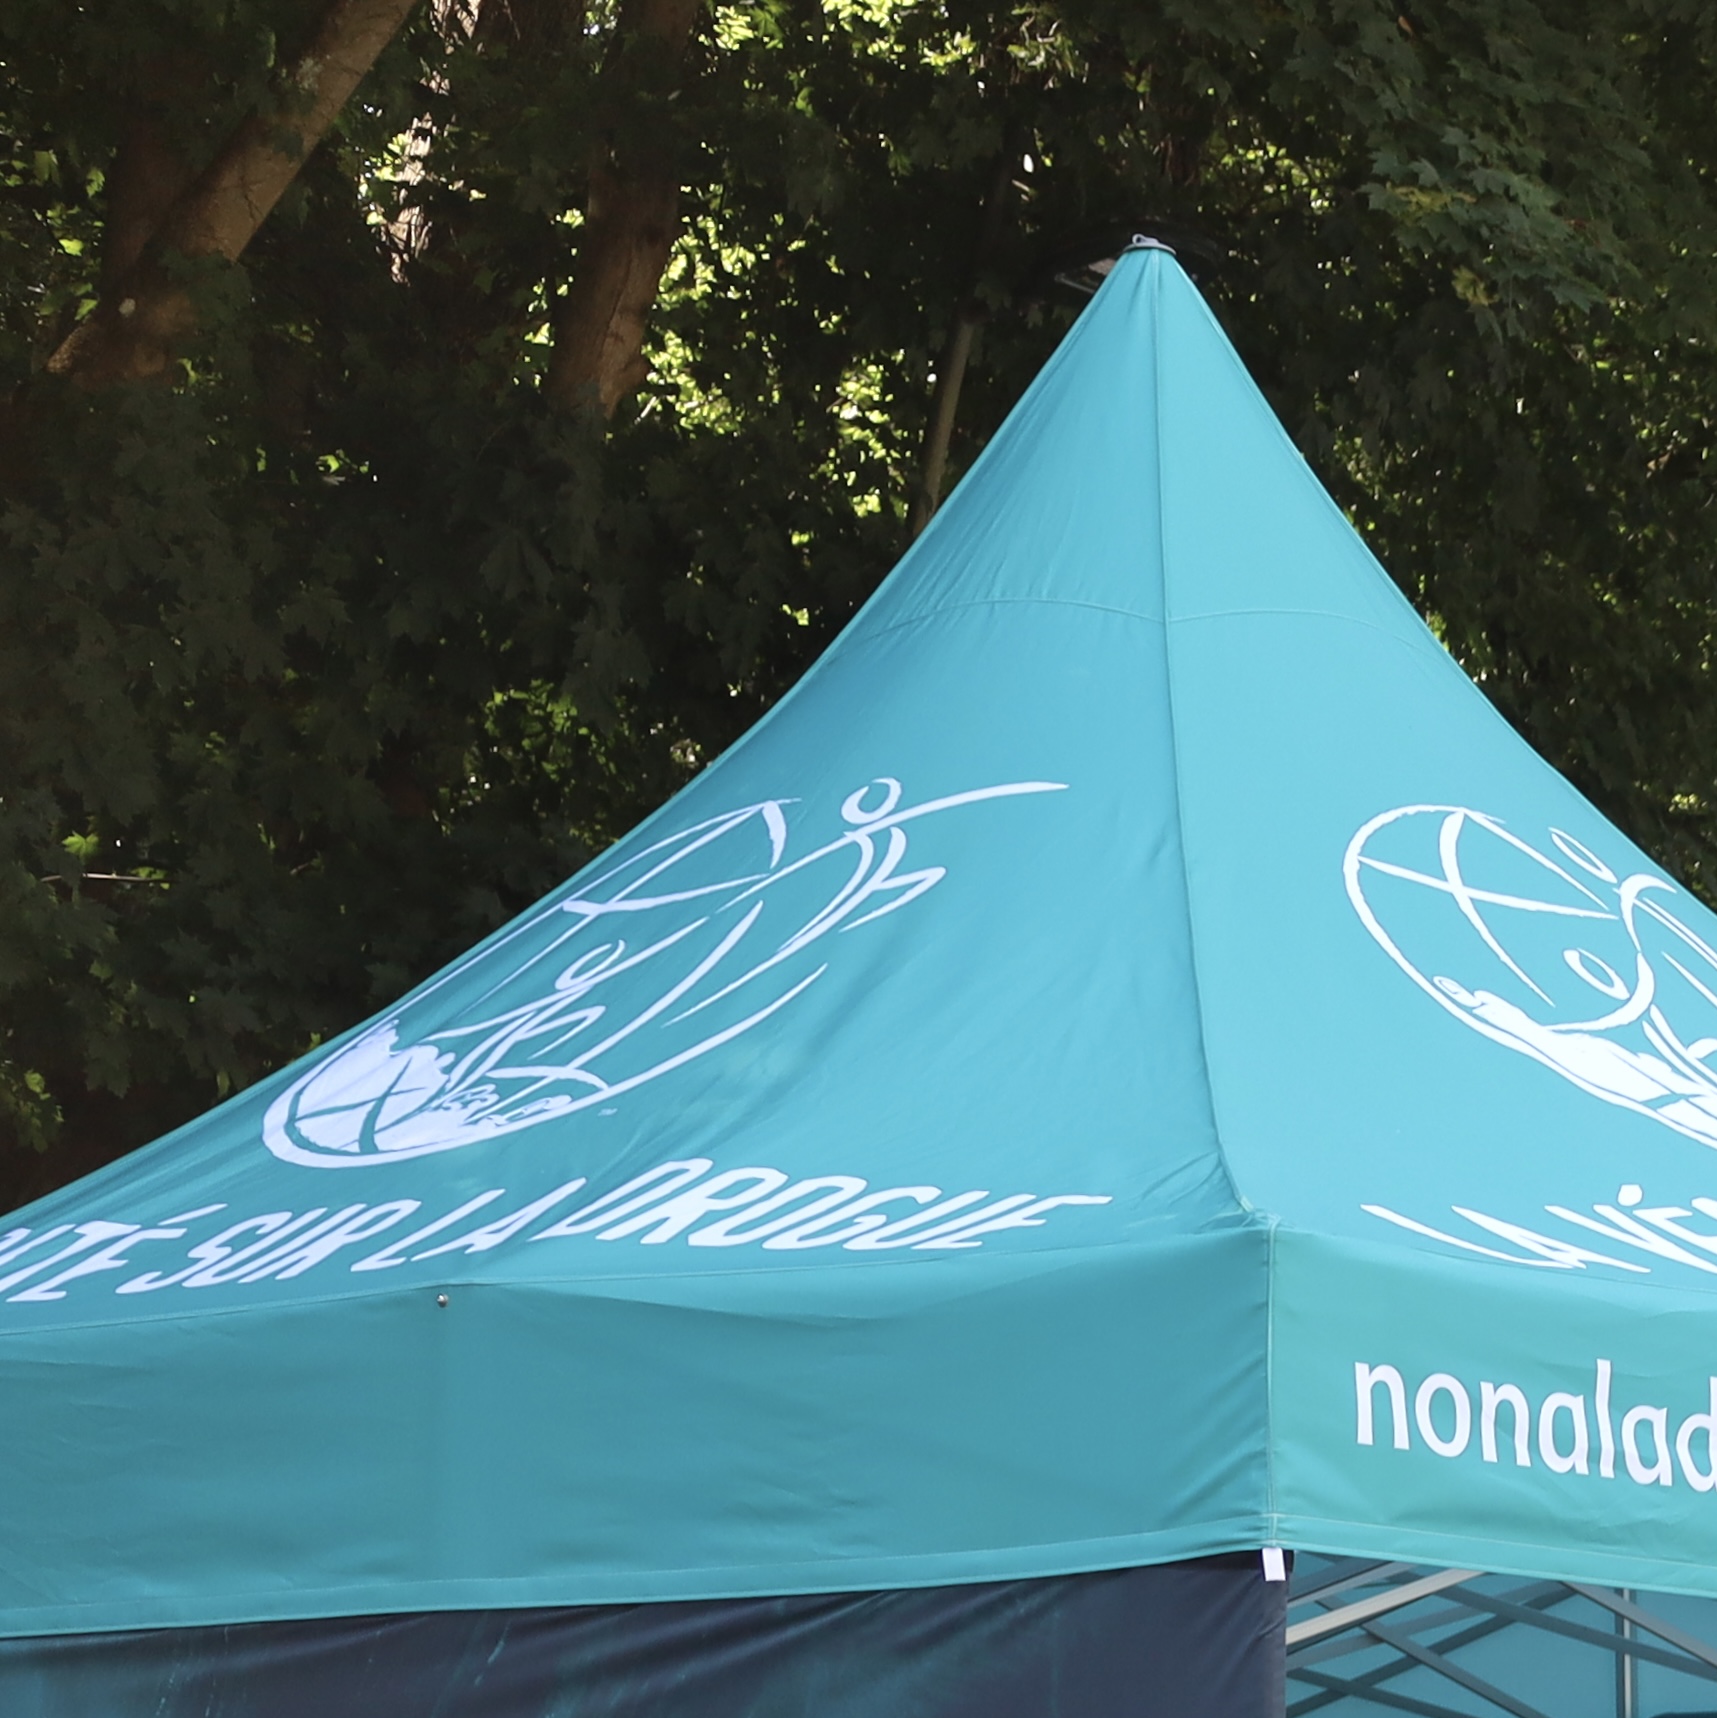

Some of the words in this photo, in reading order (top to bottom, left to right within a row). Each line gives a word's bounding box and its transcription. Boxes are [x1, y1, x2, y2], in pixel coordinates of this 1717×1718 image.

[0, 1203, 228, 1303] ITÉ
[116, 1198, 421, 1294] SUR
[351, 1178, 586, 1272] LA
[527, 1155, 1112, 1254] DROGUE
[1361, 1203, 1651, 1273] LA
